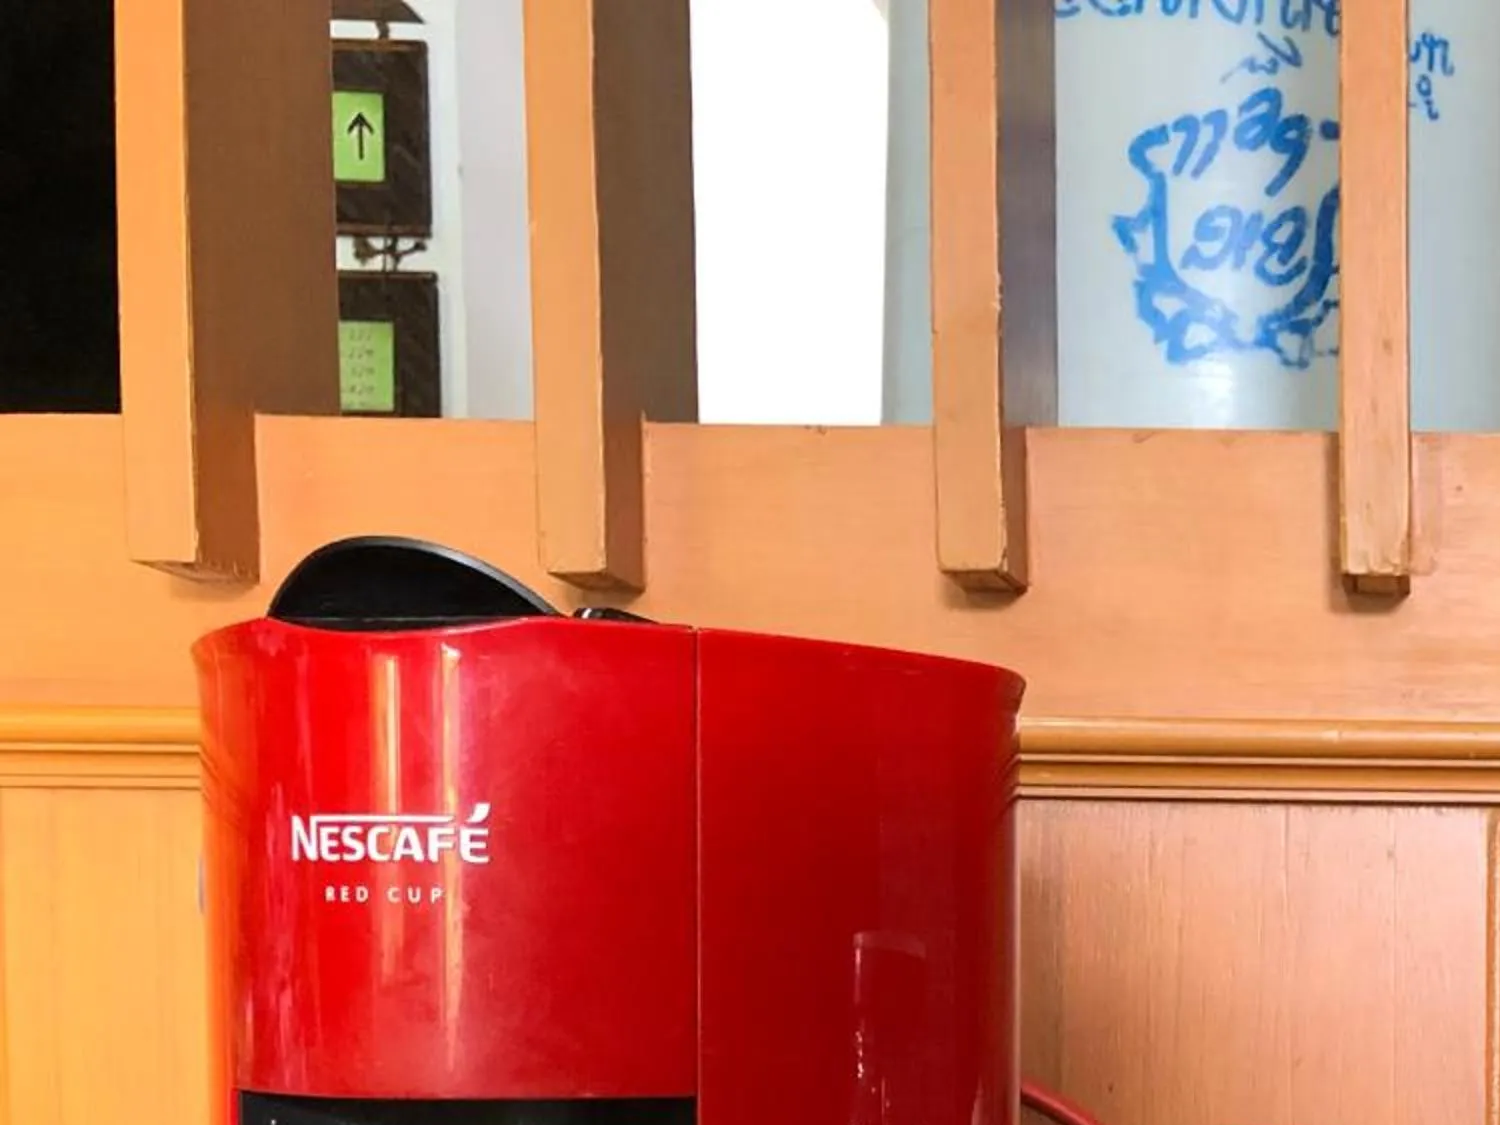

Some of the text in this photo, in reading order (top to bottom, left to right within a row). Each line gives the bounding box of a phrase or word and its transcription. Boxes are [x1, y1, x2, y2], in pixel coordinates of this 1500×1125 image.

[291, 803, 490, 863] NESCAFÉ
[325, 886, 443, 903] RED CUP
